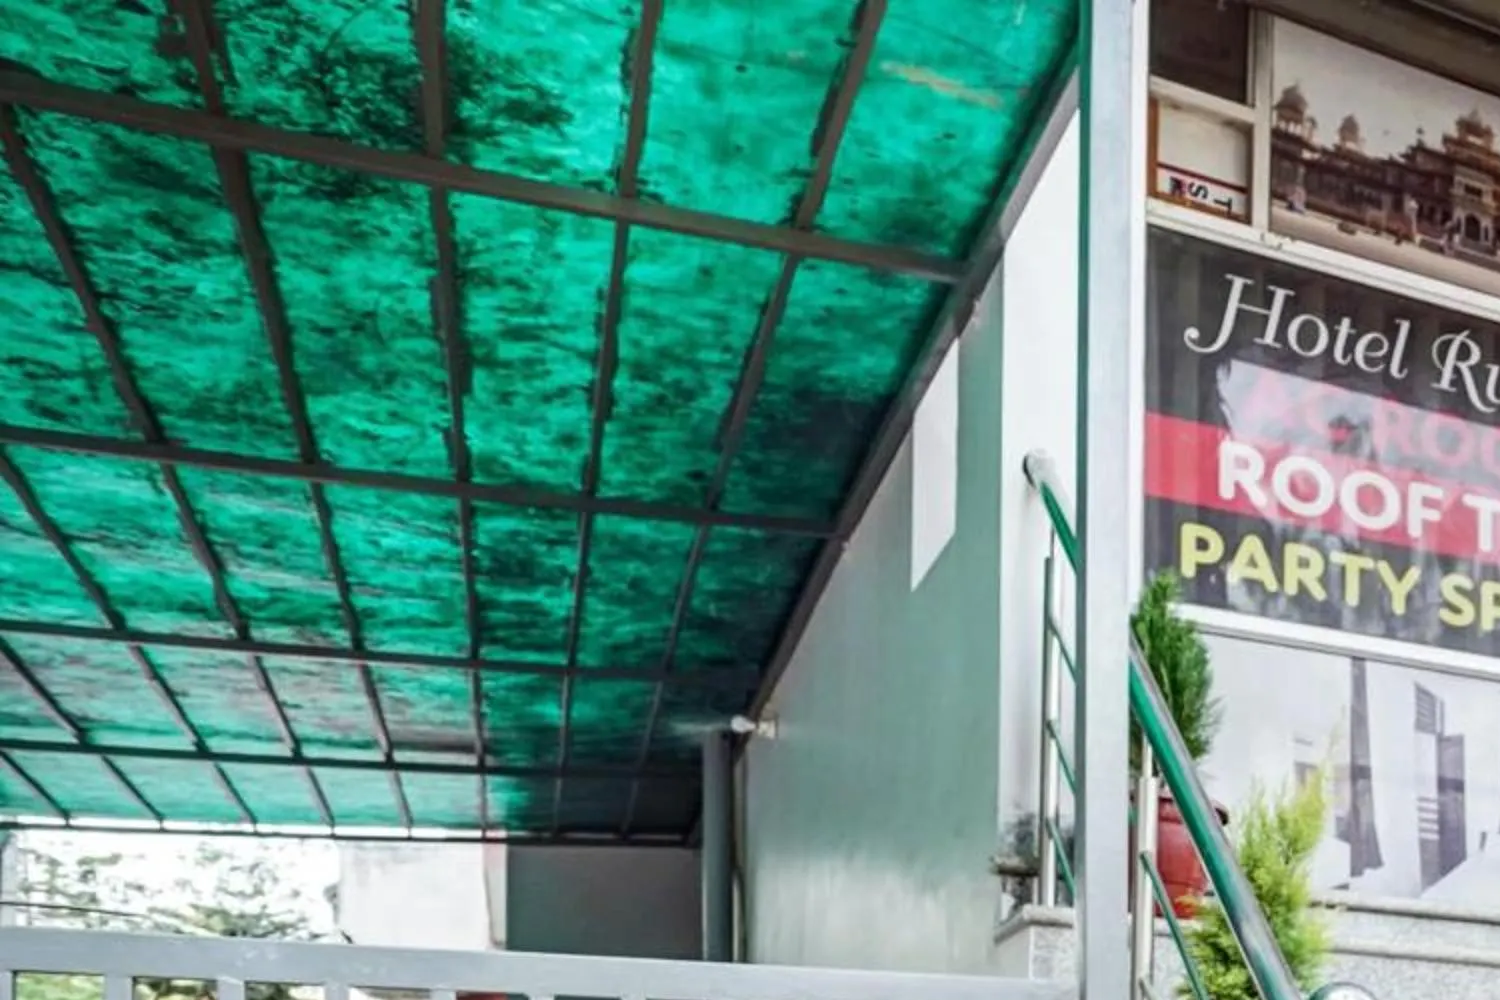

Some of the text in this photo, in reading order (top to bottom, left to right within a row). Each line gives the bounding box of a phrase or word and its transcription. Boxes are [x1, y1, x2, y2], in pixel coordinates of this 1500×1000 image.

[1183, 274, 1409, 381] Hotel
[1216, 440, 1443, 539] ROOF
[1179, 522, 1424, 616] PARTY
